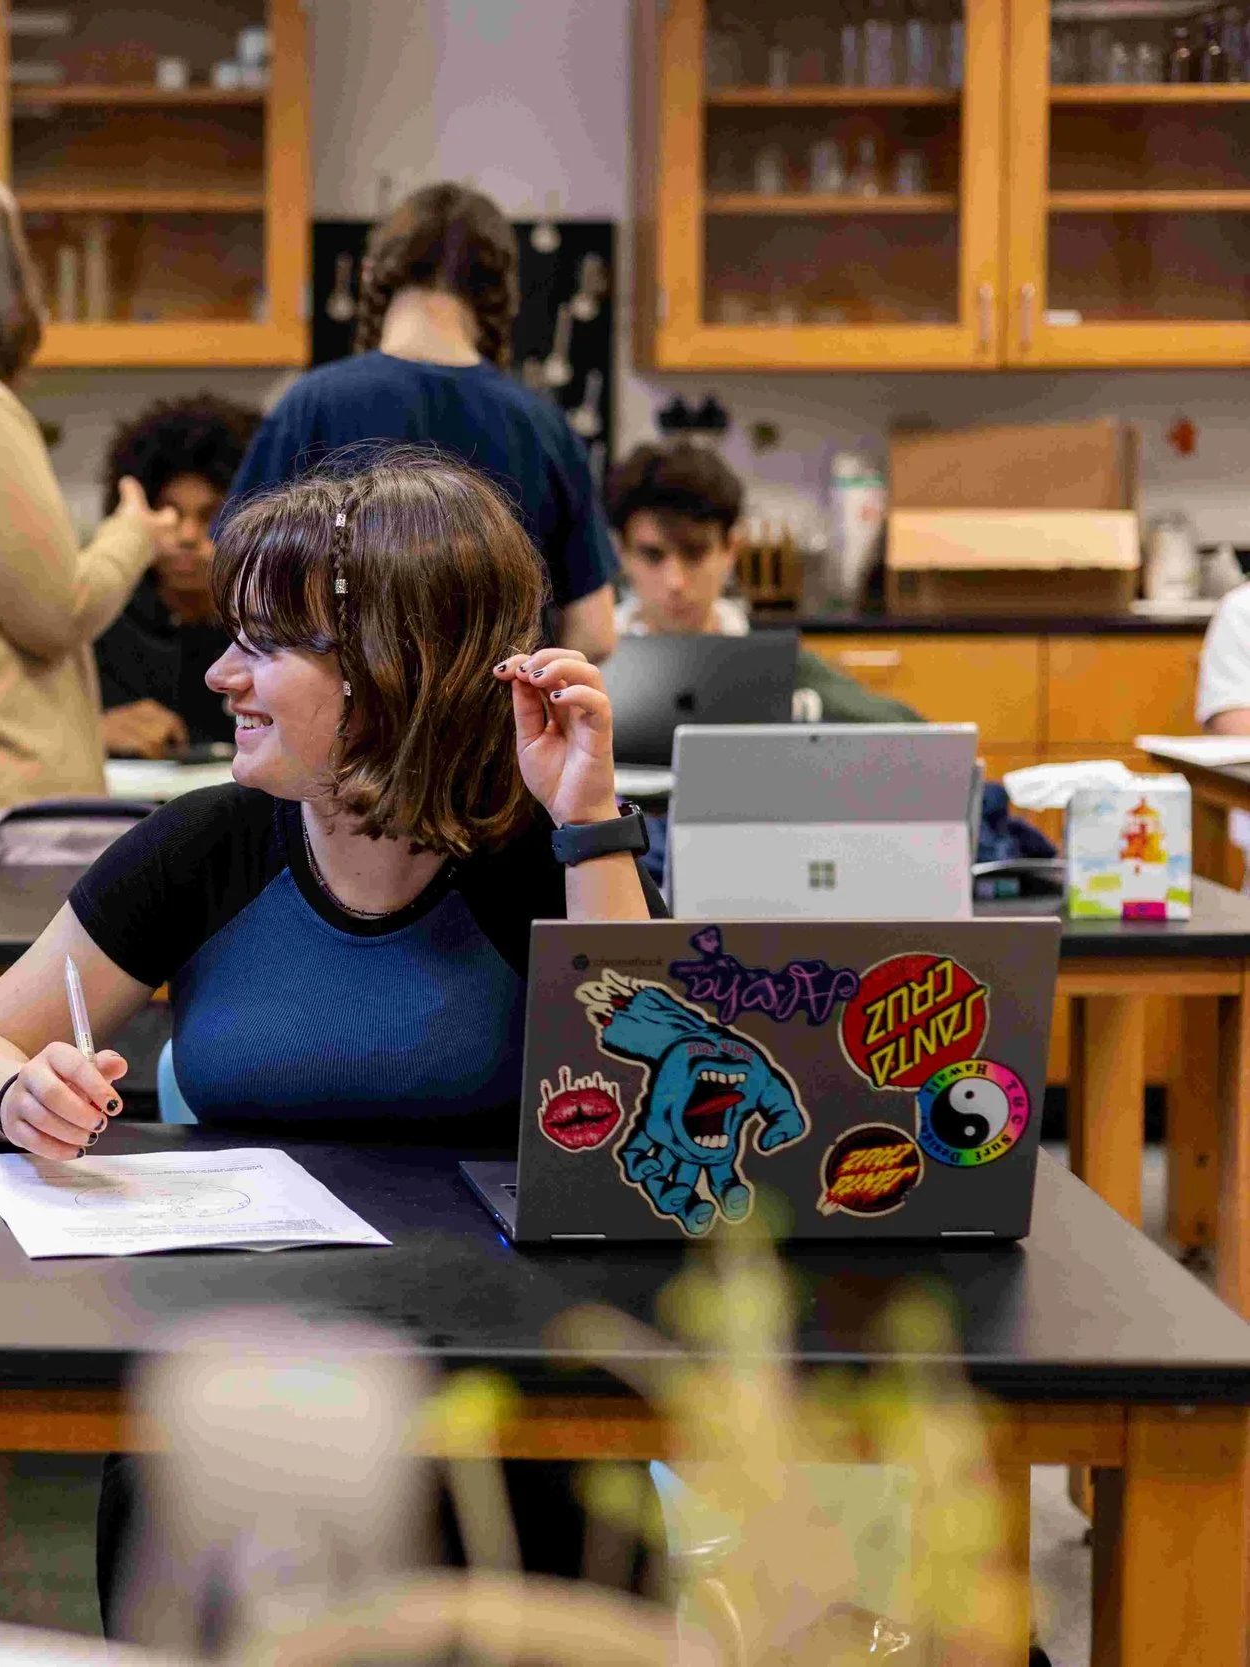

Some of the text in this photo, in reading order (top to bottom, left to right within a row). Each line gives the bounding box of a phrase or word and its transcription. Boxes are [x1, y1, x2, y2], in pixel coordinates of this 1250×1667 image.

[865, 960, 954, 1044] CRUZ
[869, 987, 986, 1087] SANTA
[974, 1134, 1012, 1163] Surf
